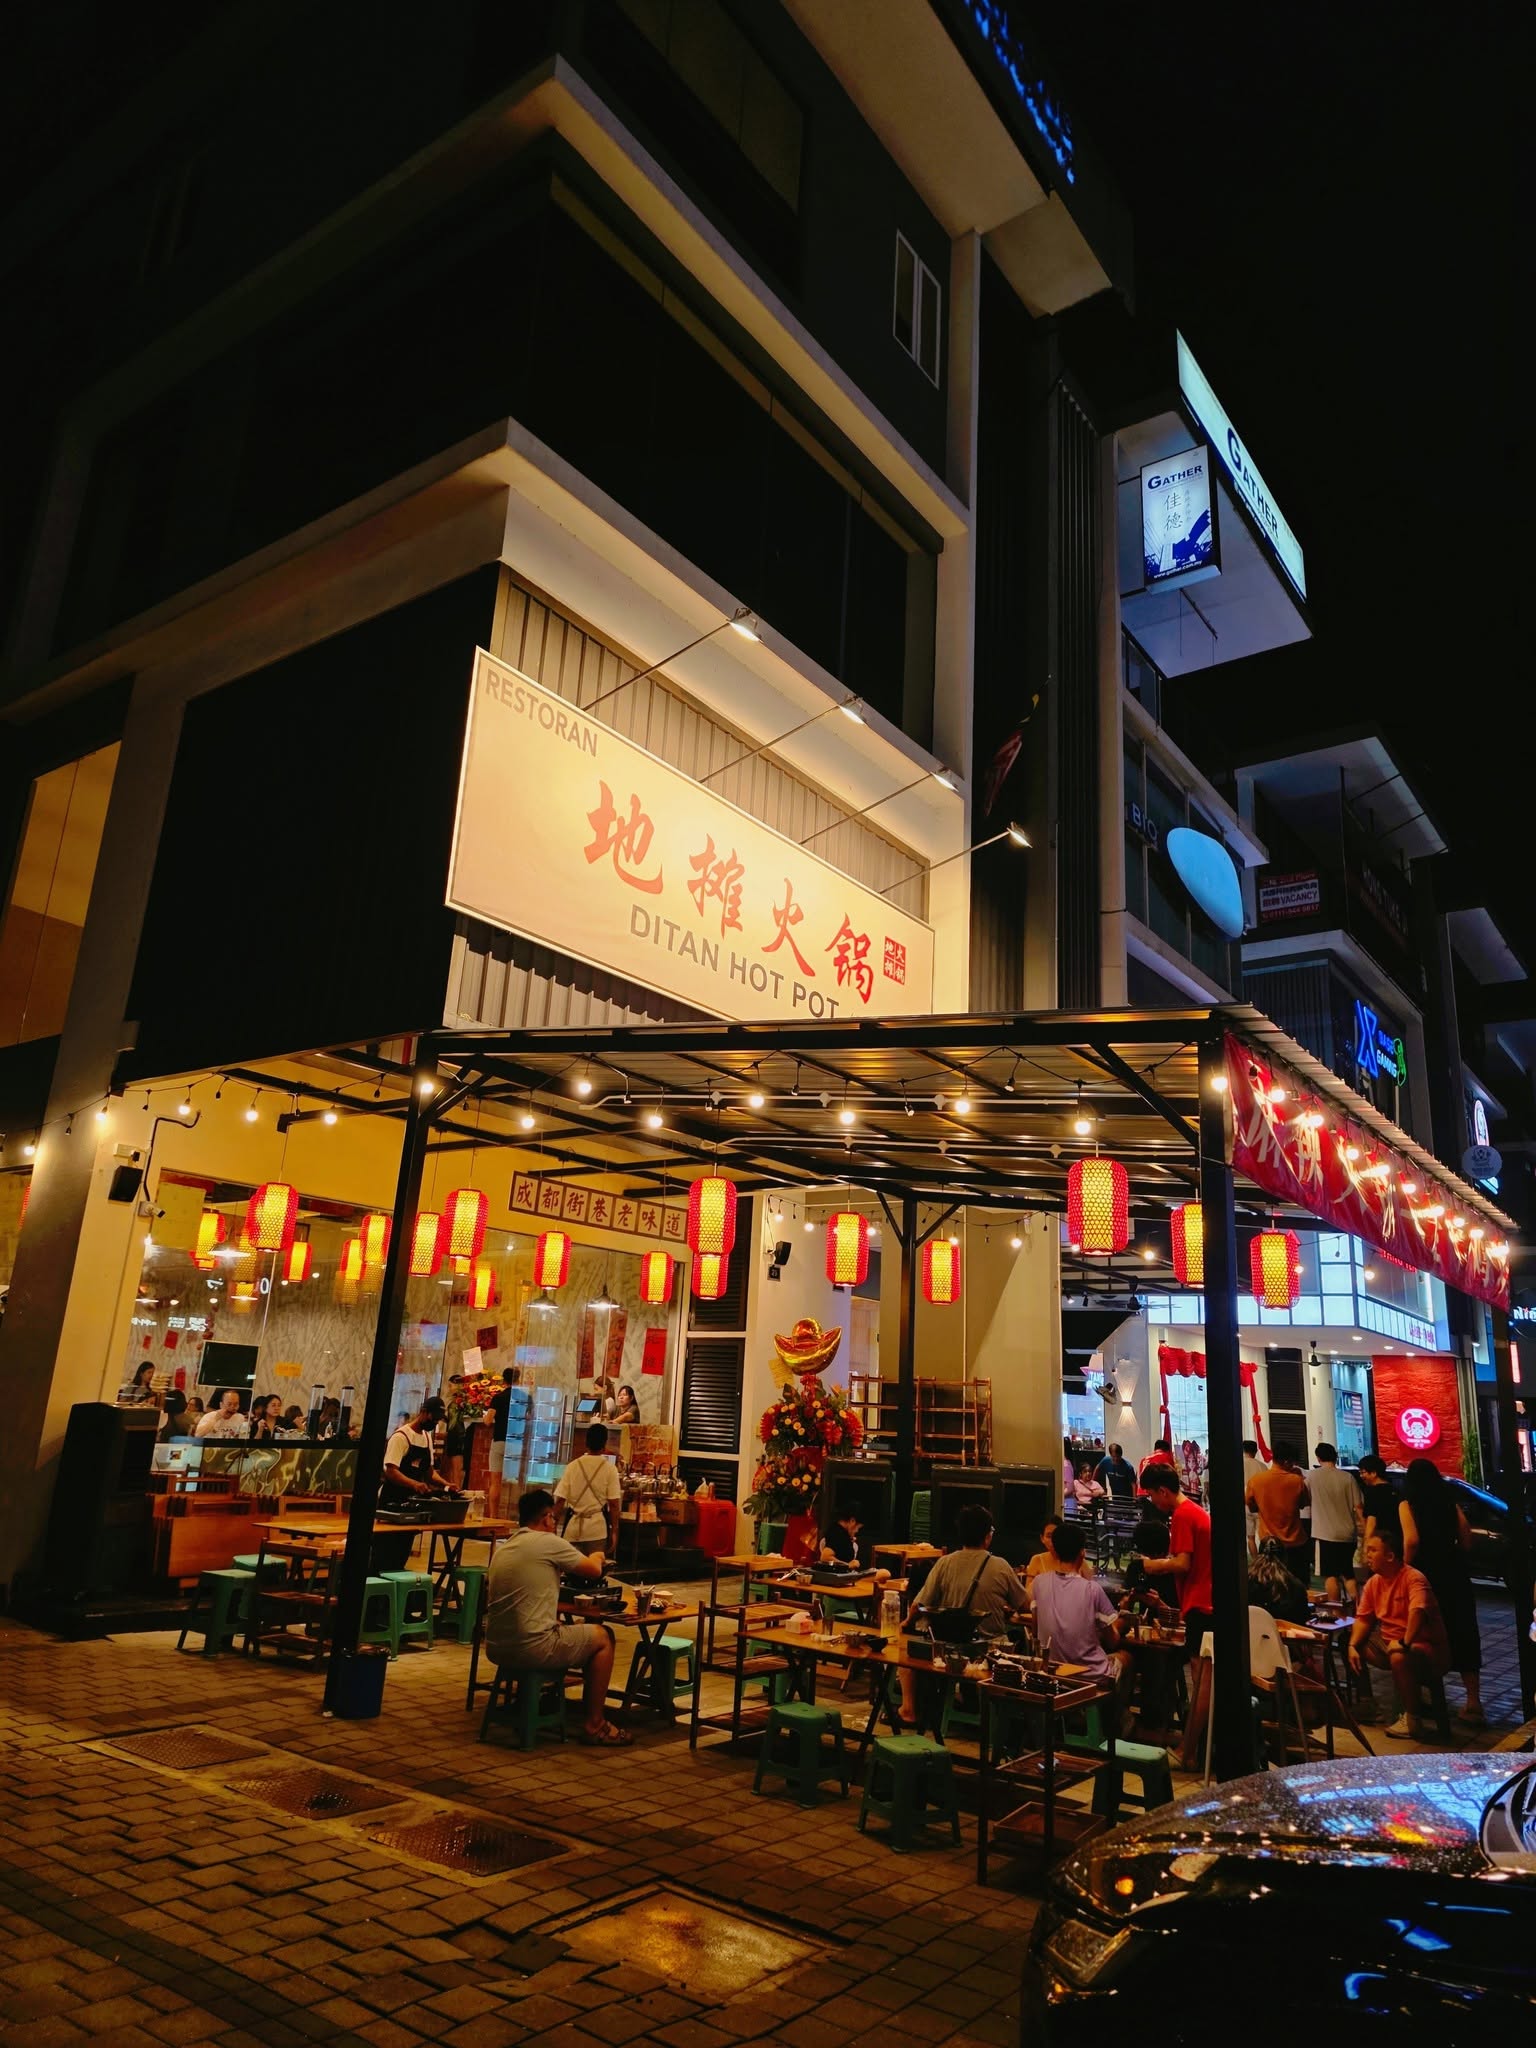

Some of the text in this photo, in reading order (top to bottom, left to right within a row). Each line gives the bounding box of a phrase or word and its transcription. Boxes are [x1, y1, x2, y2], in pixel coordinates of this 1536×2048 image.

[1147, 465, 1203, 490] GATHER
[1227, 427, 1279, 538] GATHER
[485, 667, 598, 757] RESTORAN
[1280, 890, 1318, 905] VACANCY
[630, 903, 840, 1019] DITAN HOT POT
[516, 1180, 682, 1237] 成都街巷老味道
